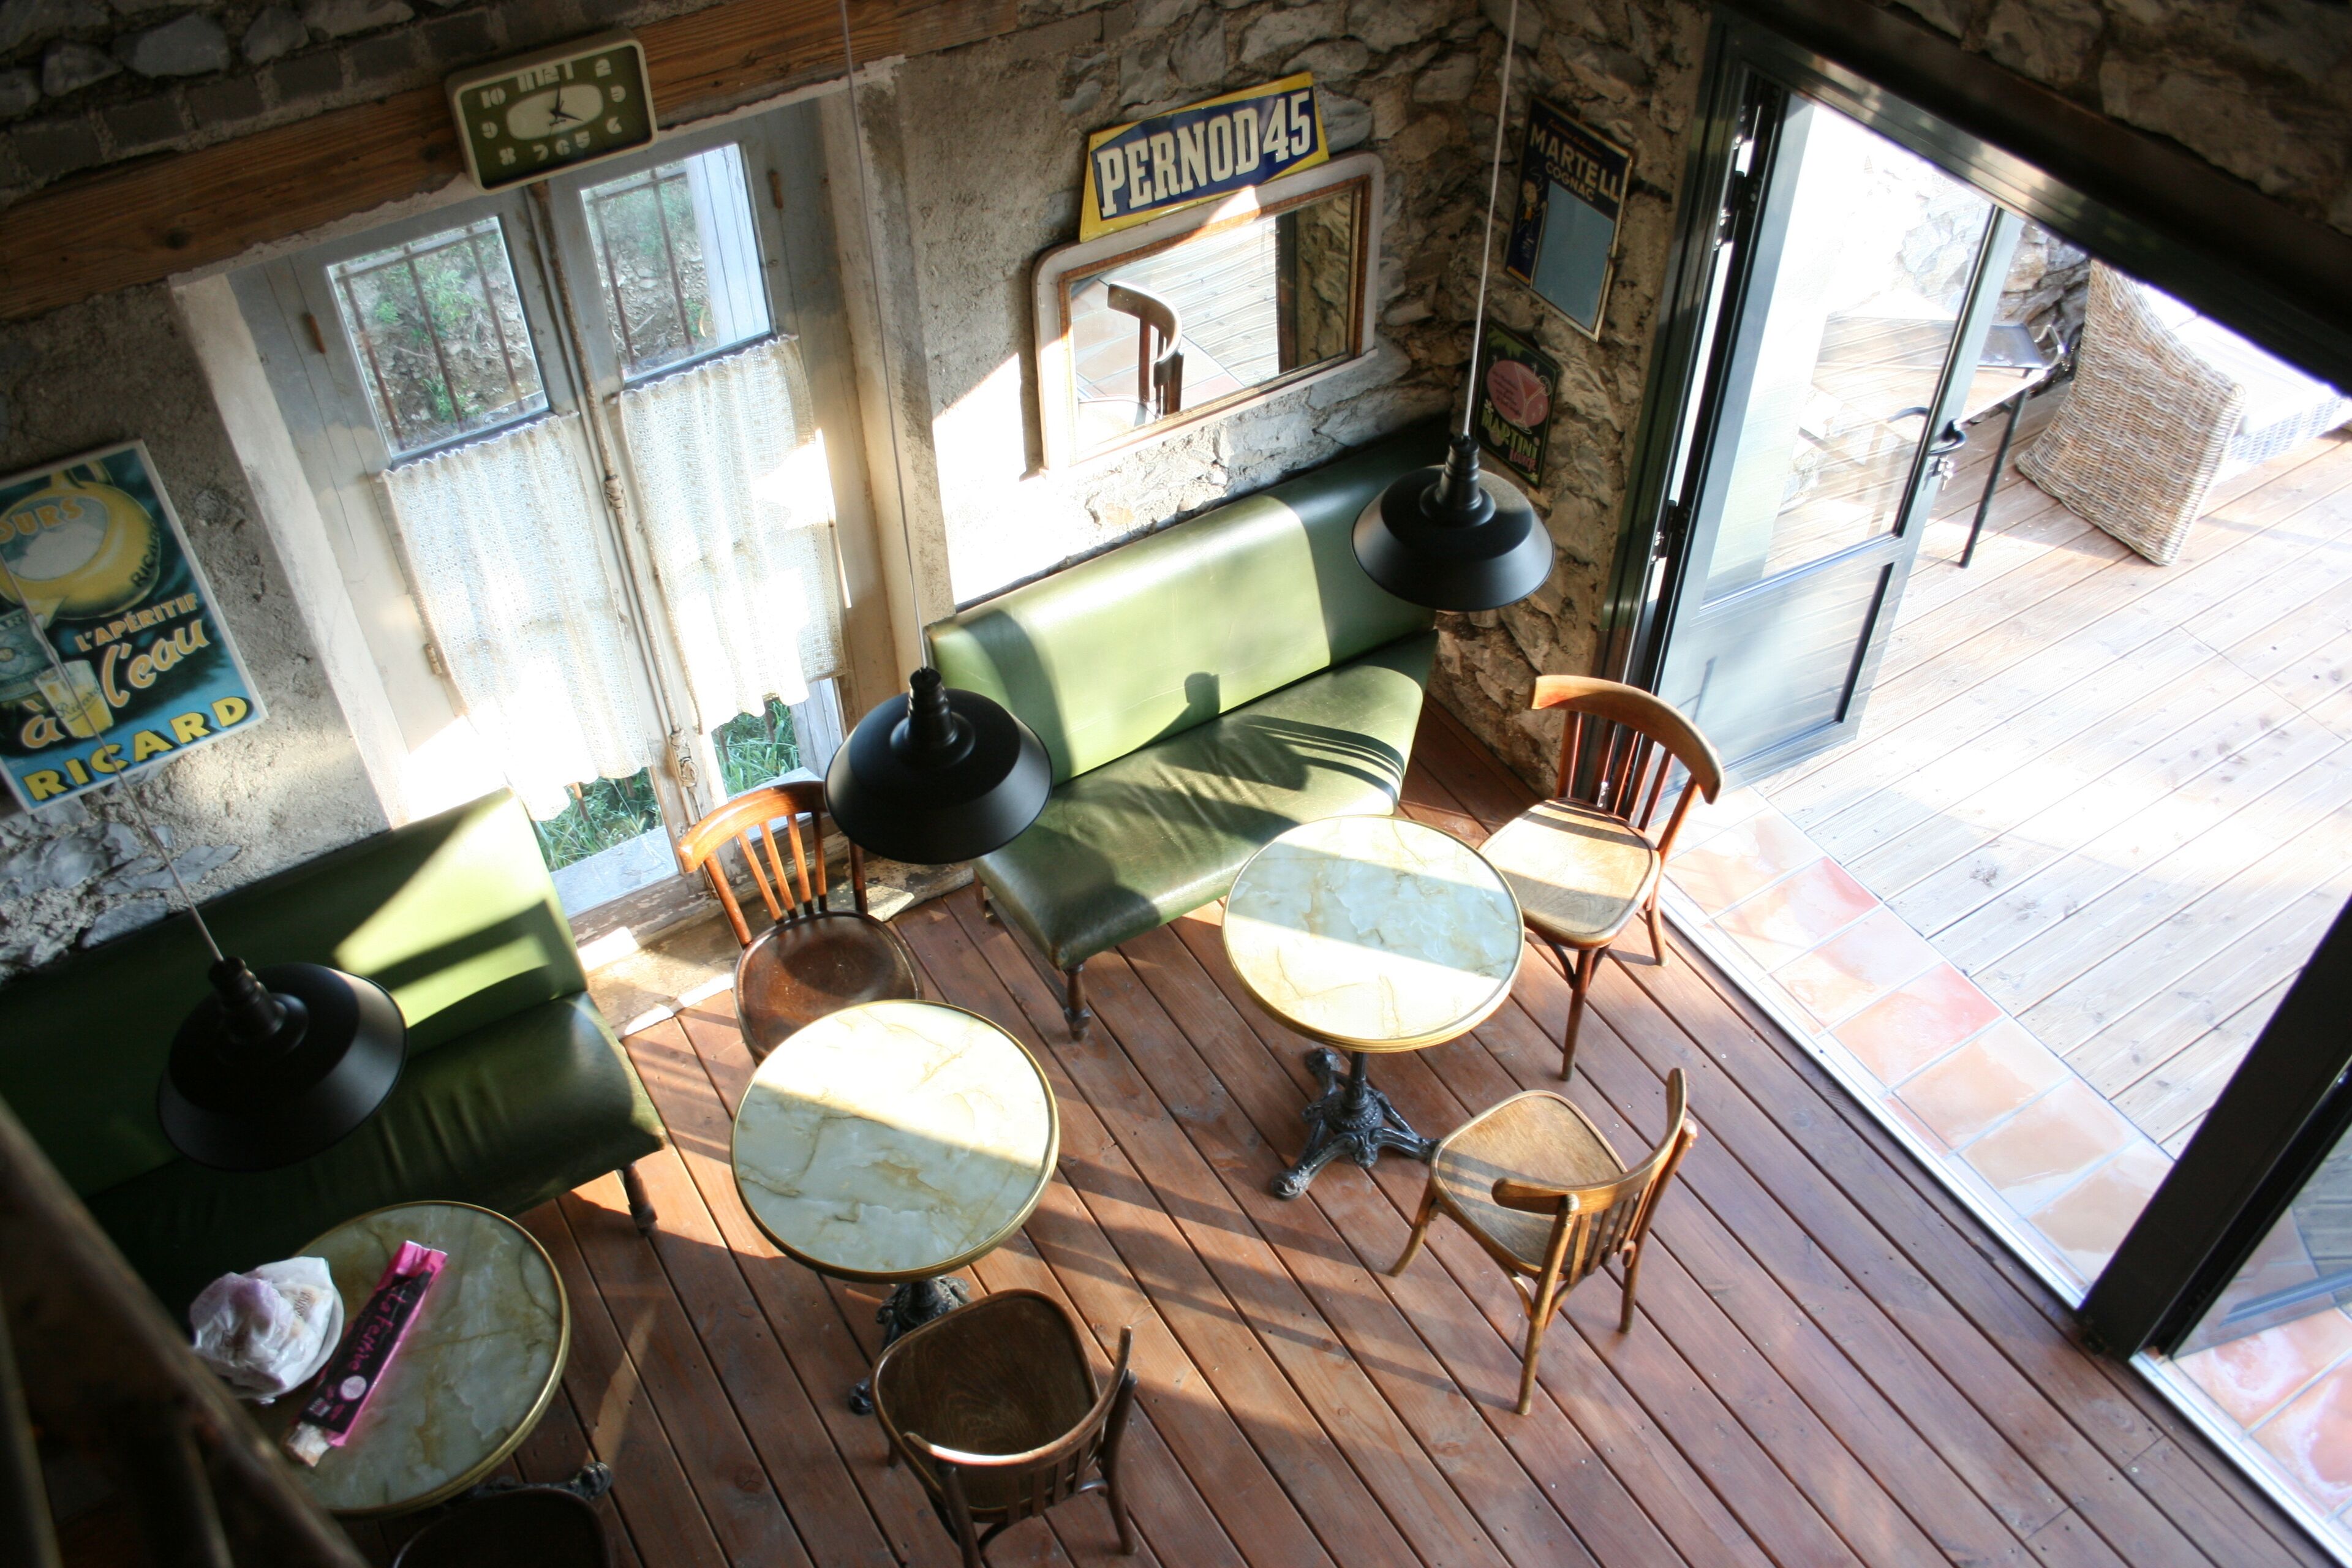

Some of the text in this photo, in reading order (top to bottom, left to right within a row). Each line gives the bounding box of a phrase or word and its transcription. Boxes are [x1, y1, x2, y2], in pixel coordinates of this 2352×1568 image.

[595, 59, 612, 78] 2
[481, 88, 506, 109] 10
[611, 85, 626, 102] 3
[481, 121, 498, 139] 9
[606, 117, 622, 134] 4
[556, 140, 570, 156] 6
[575, 130, 590, 148] 5
[499, 147, 516, 165] 8
[532, 143, 549, 162] 7
[1097, 91, 1311, 217] PERNOD 45
[1529, 123, 1619, 204] MARTELL
[1545, 160, 1594, 202] COGNAC
[1481, 408, 1537, 459] MARTINI
[74, 593, 201, 653] L'APÉRITIF
[21, 619, 211, 748] à l'eau
[22, 696, 251, 802] RICARD
